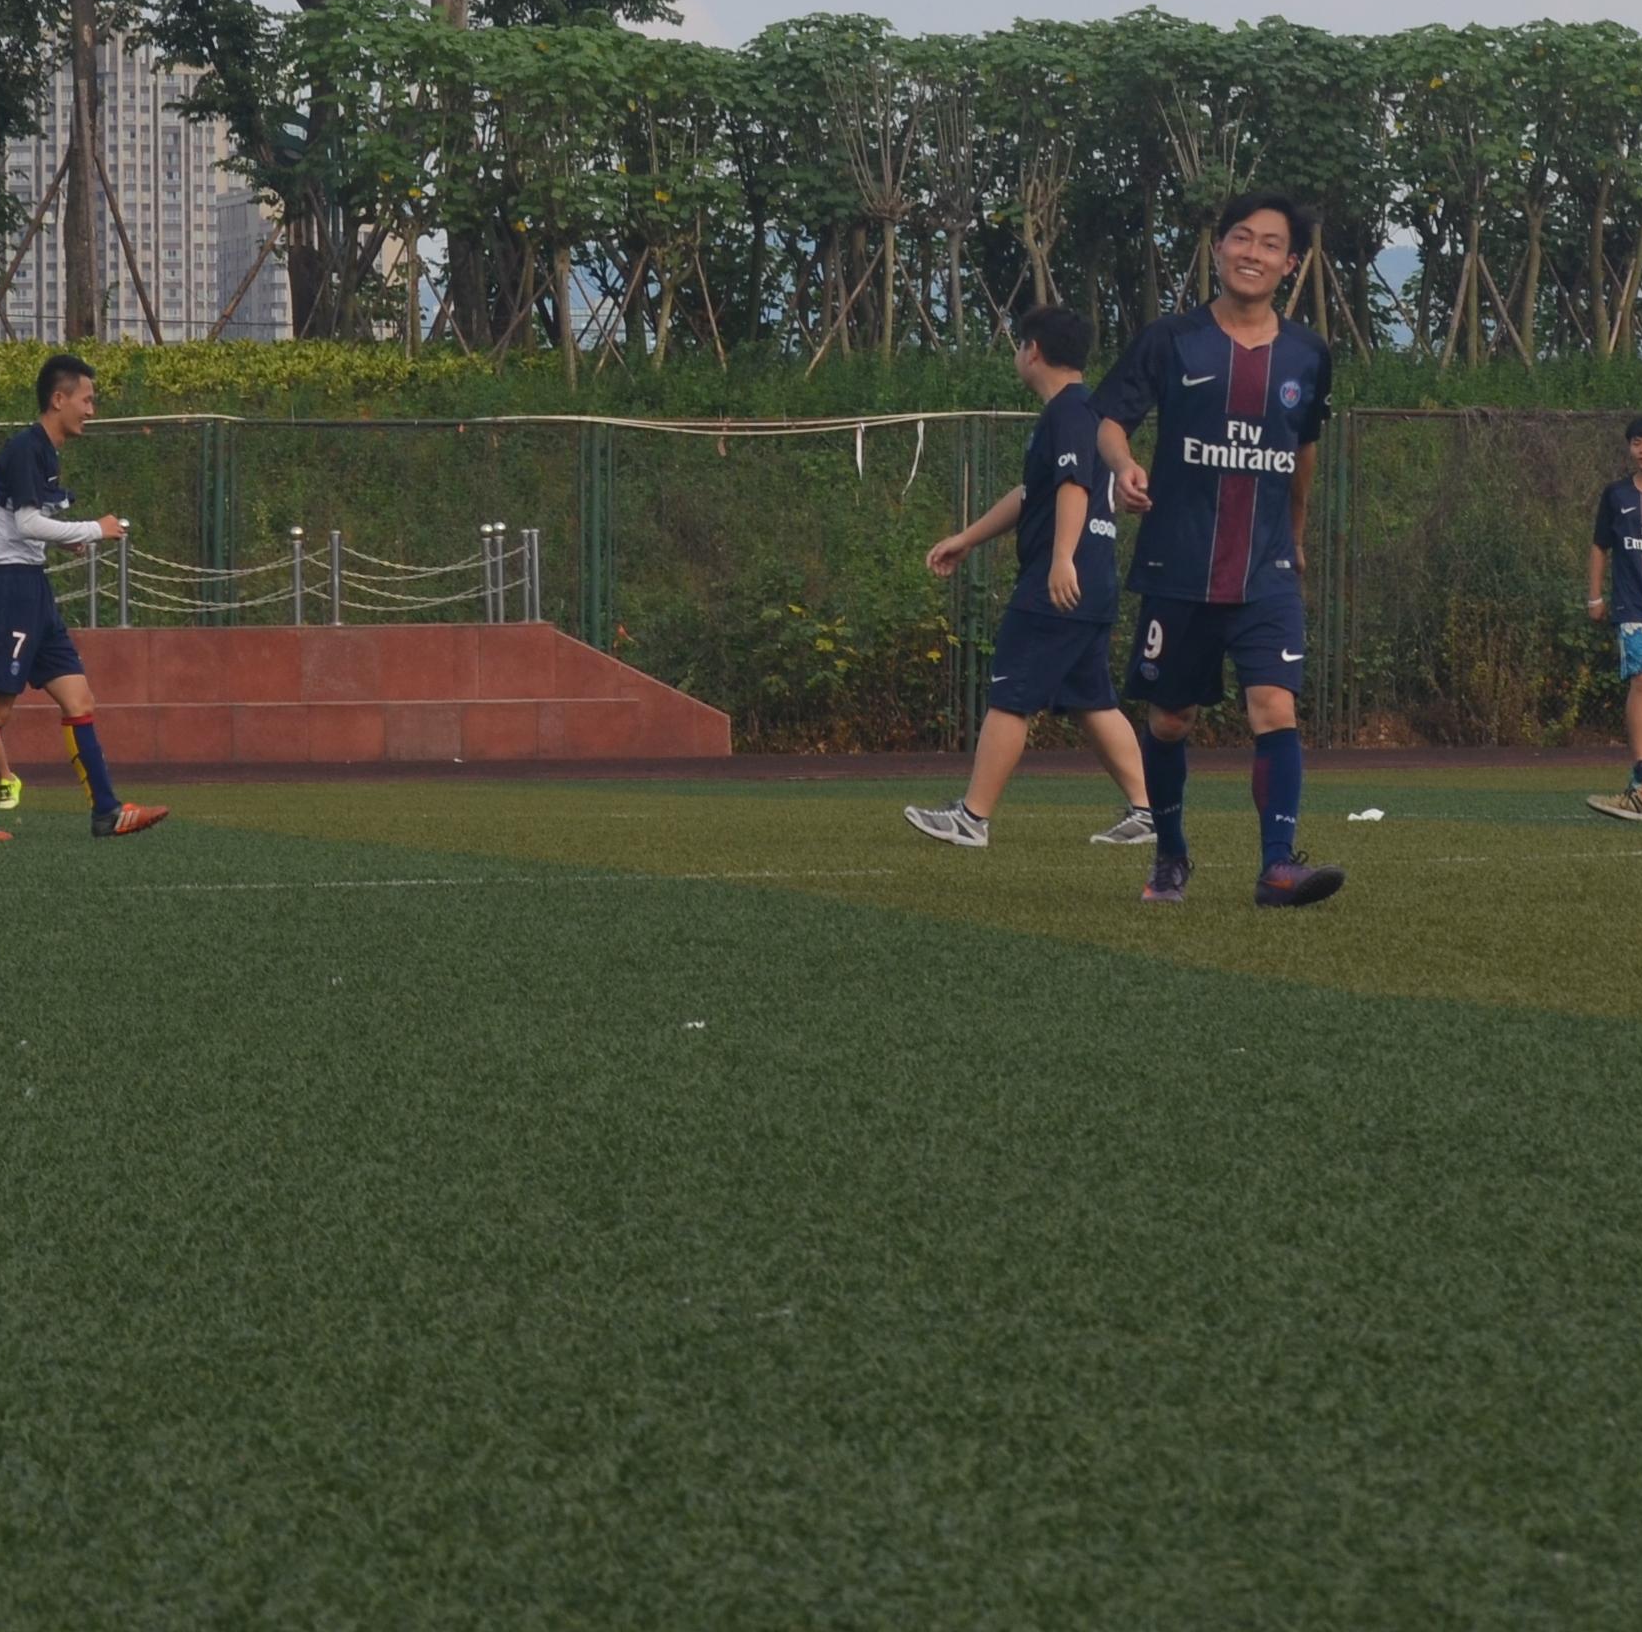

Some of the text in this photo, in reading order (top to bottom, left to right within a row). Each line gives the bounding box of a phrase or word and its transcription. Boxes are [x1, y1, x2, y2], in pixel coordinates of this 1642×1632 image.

[1227, 420, 1262, 445] Fly
[1183, 437, 1295, 474] Emirates
[12, 631, 27, 659] 7
[1143, 619, 1163, 660] 9
